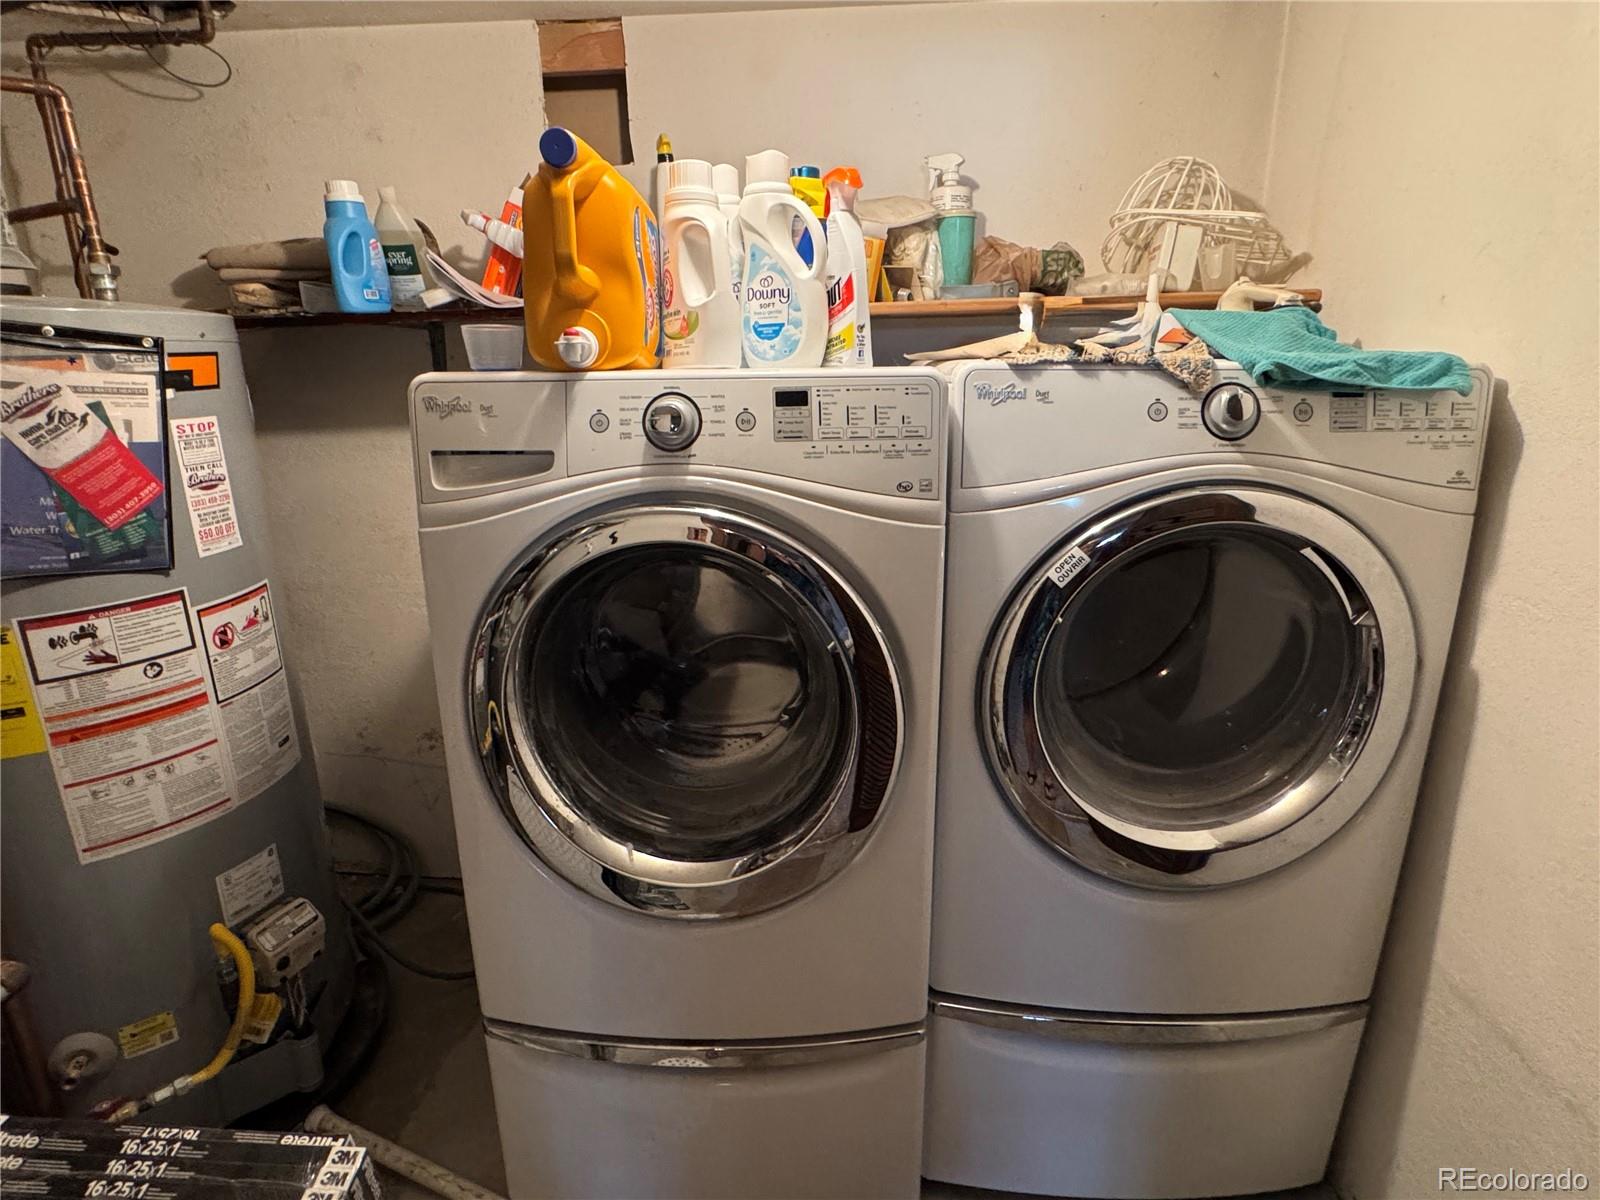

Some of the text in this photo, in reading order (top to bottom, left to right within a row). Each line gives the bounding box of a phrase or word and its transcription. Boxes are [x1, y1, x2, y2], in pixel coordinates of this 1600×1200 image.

[748, 287, 790, 304] Downy
[973, 383, 1028, 406] Whirlpool
[422, 395, 473, 420] Whirlpool
[176, 422, 216, 434] STOP
[185, 462, 224, 474] THEN CALL
[10, 525, 48, 536] Water
[198, 526, 225, 542] $50.00
[1054, 553, 1076, 574] OPEN
[1057, 556, 1086, 582] OUVRIR
[99, 608, 132, 619] DANGER
[119, 1139, 181, 1158] 16x25x1
[332, 1150, 359, 1166] 3M
[104, 1159, 168, 1178] 16x25x1
[321, 1171, 349, 1187] 3M
[84, 1181, 150, 1200] 16x25x1
